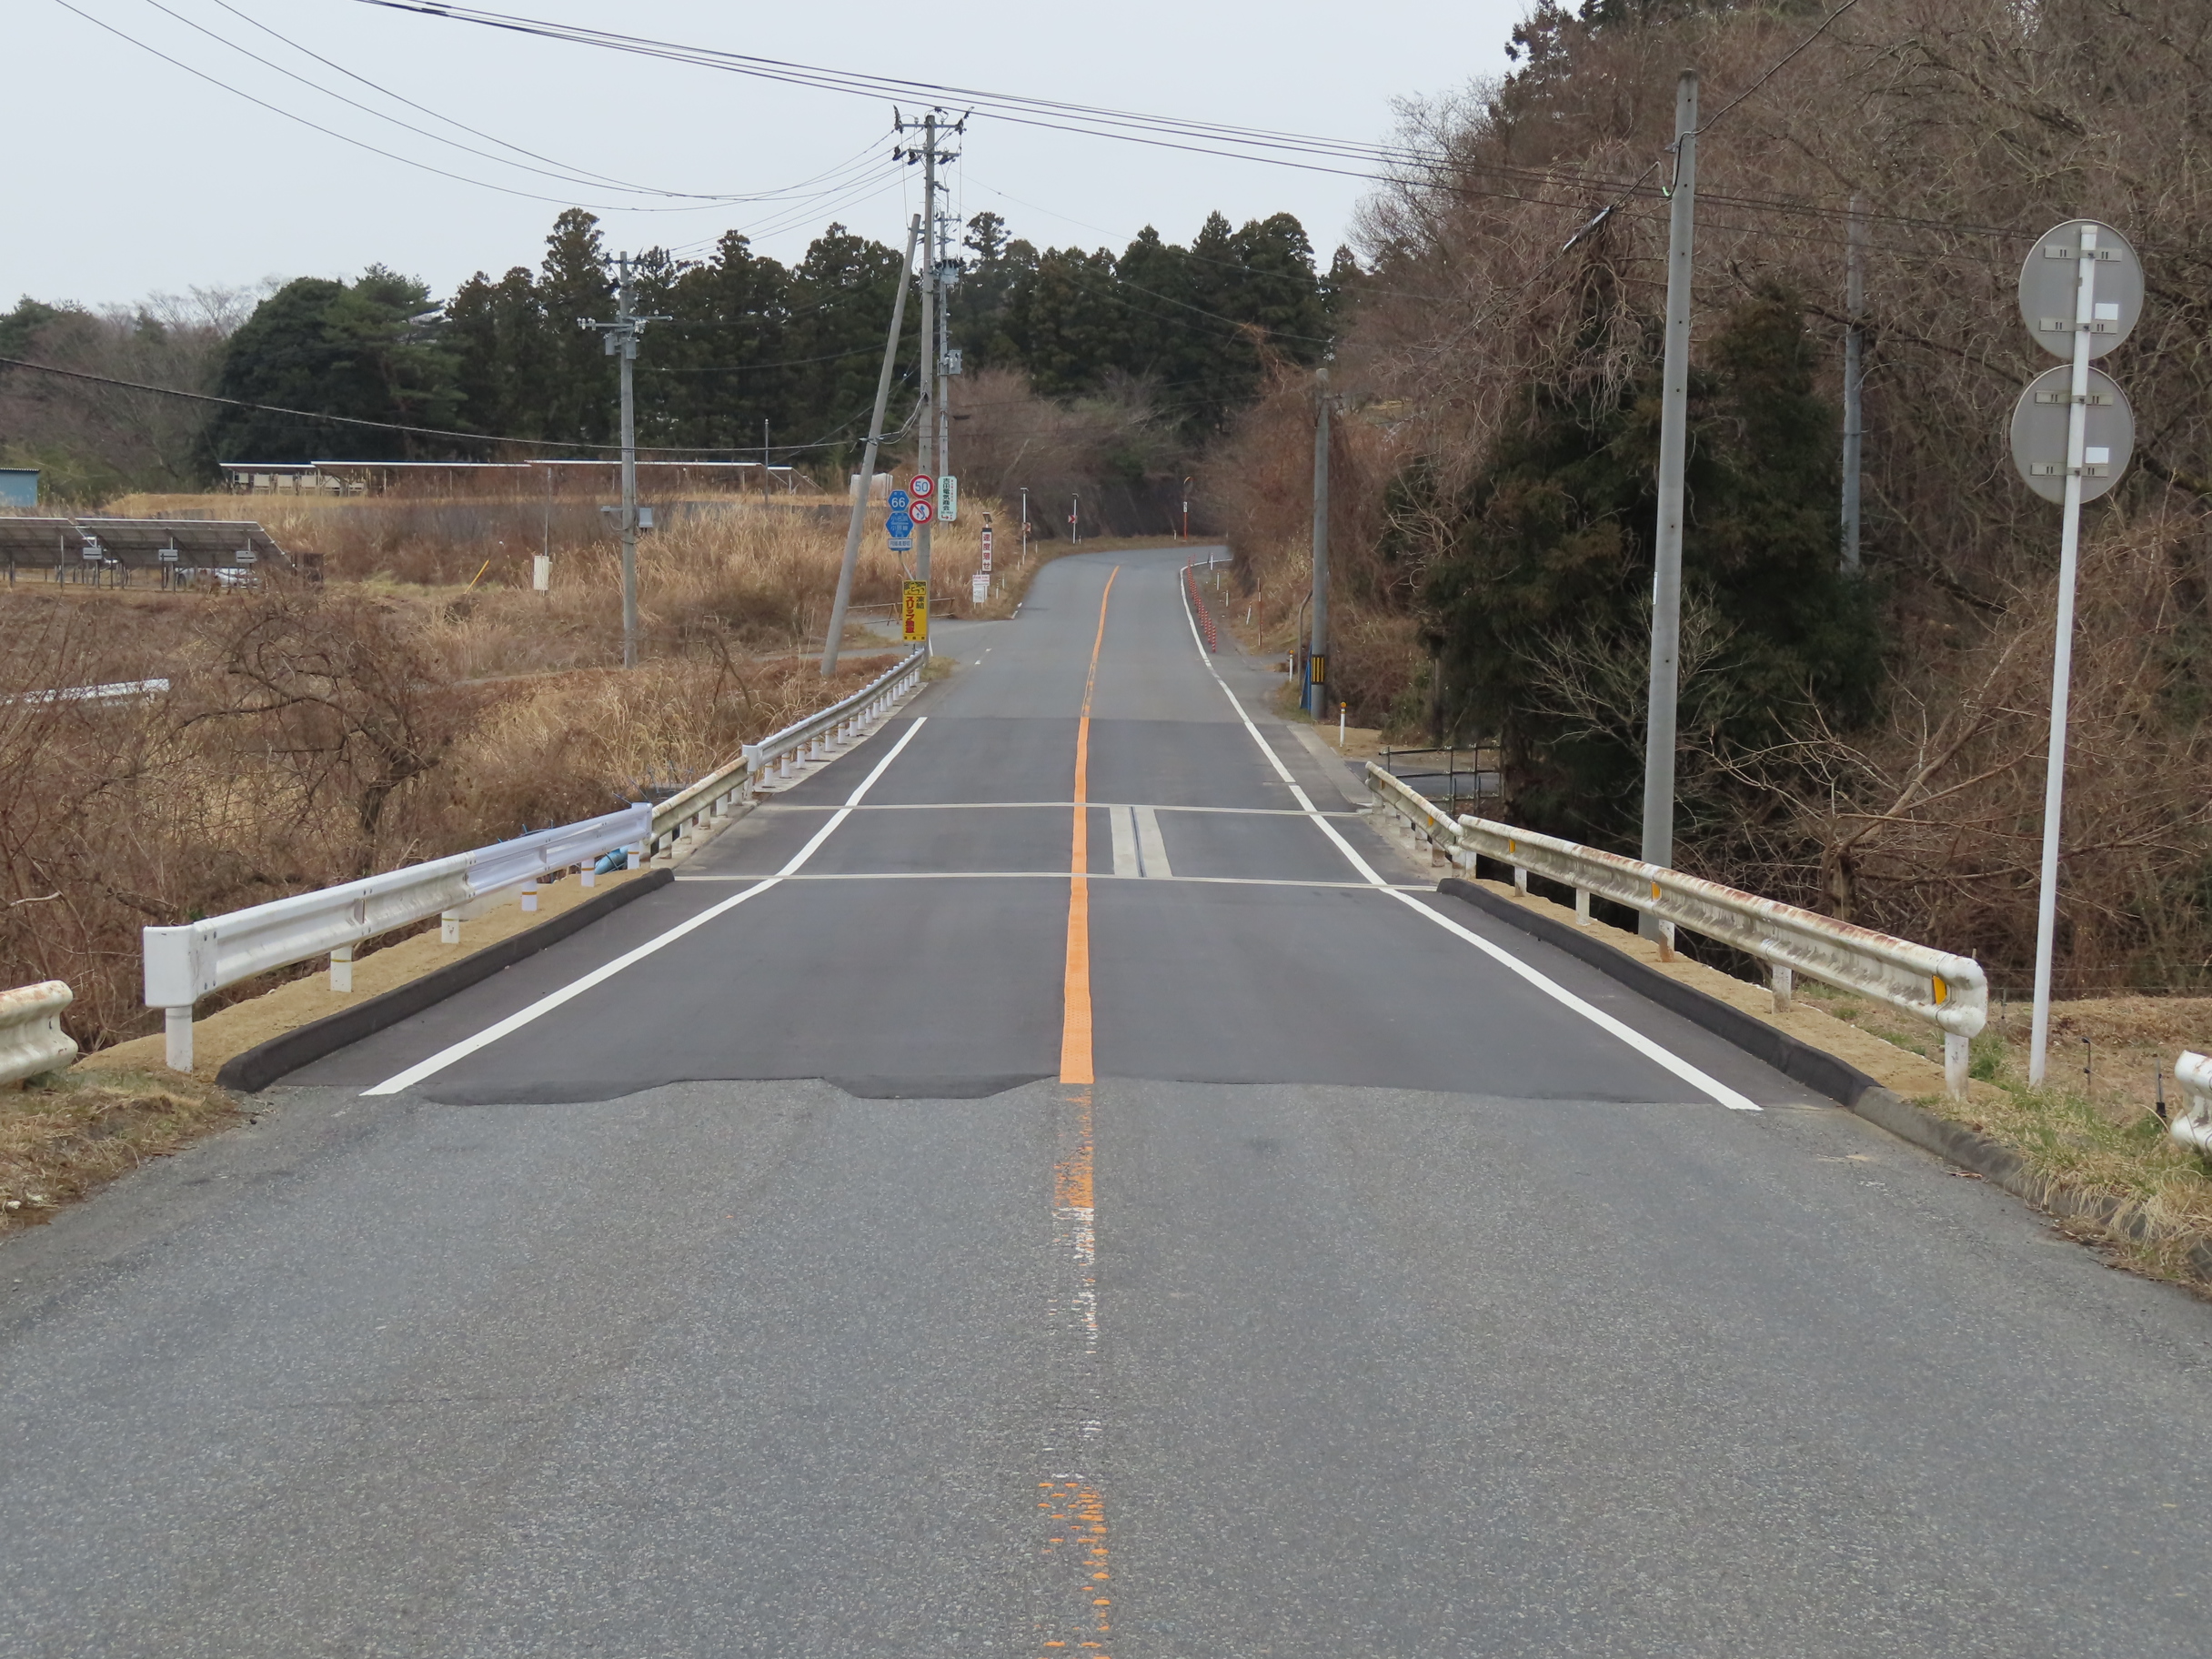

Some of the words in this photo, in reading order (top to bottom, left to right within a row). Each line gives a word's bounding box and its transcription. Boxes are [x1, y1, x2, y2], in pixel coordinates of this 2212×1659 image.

[915, 481, 929, 492] 50
[891, 498, 906, 508] 66
[982, 534, 990, 569] 速度落せ
